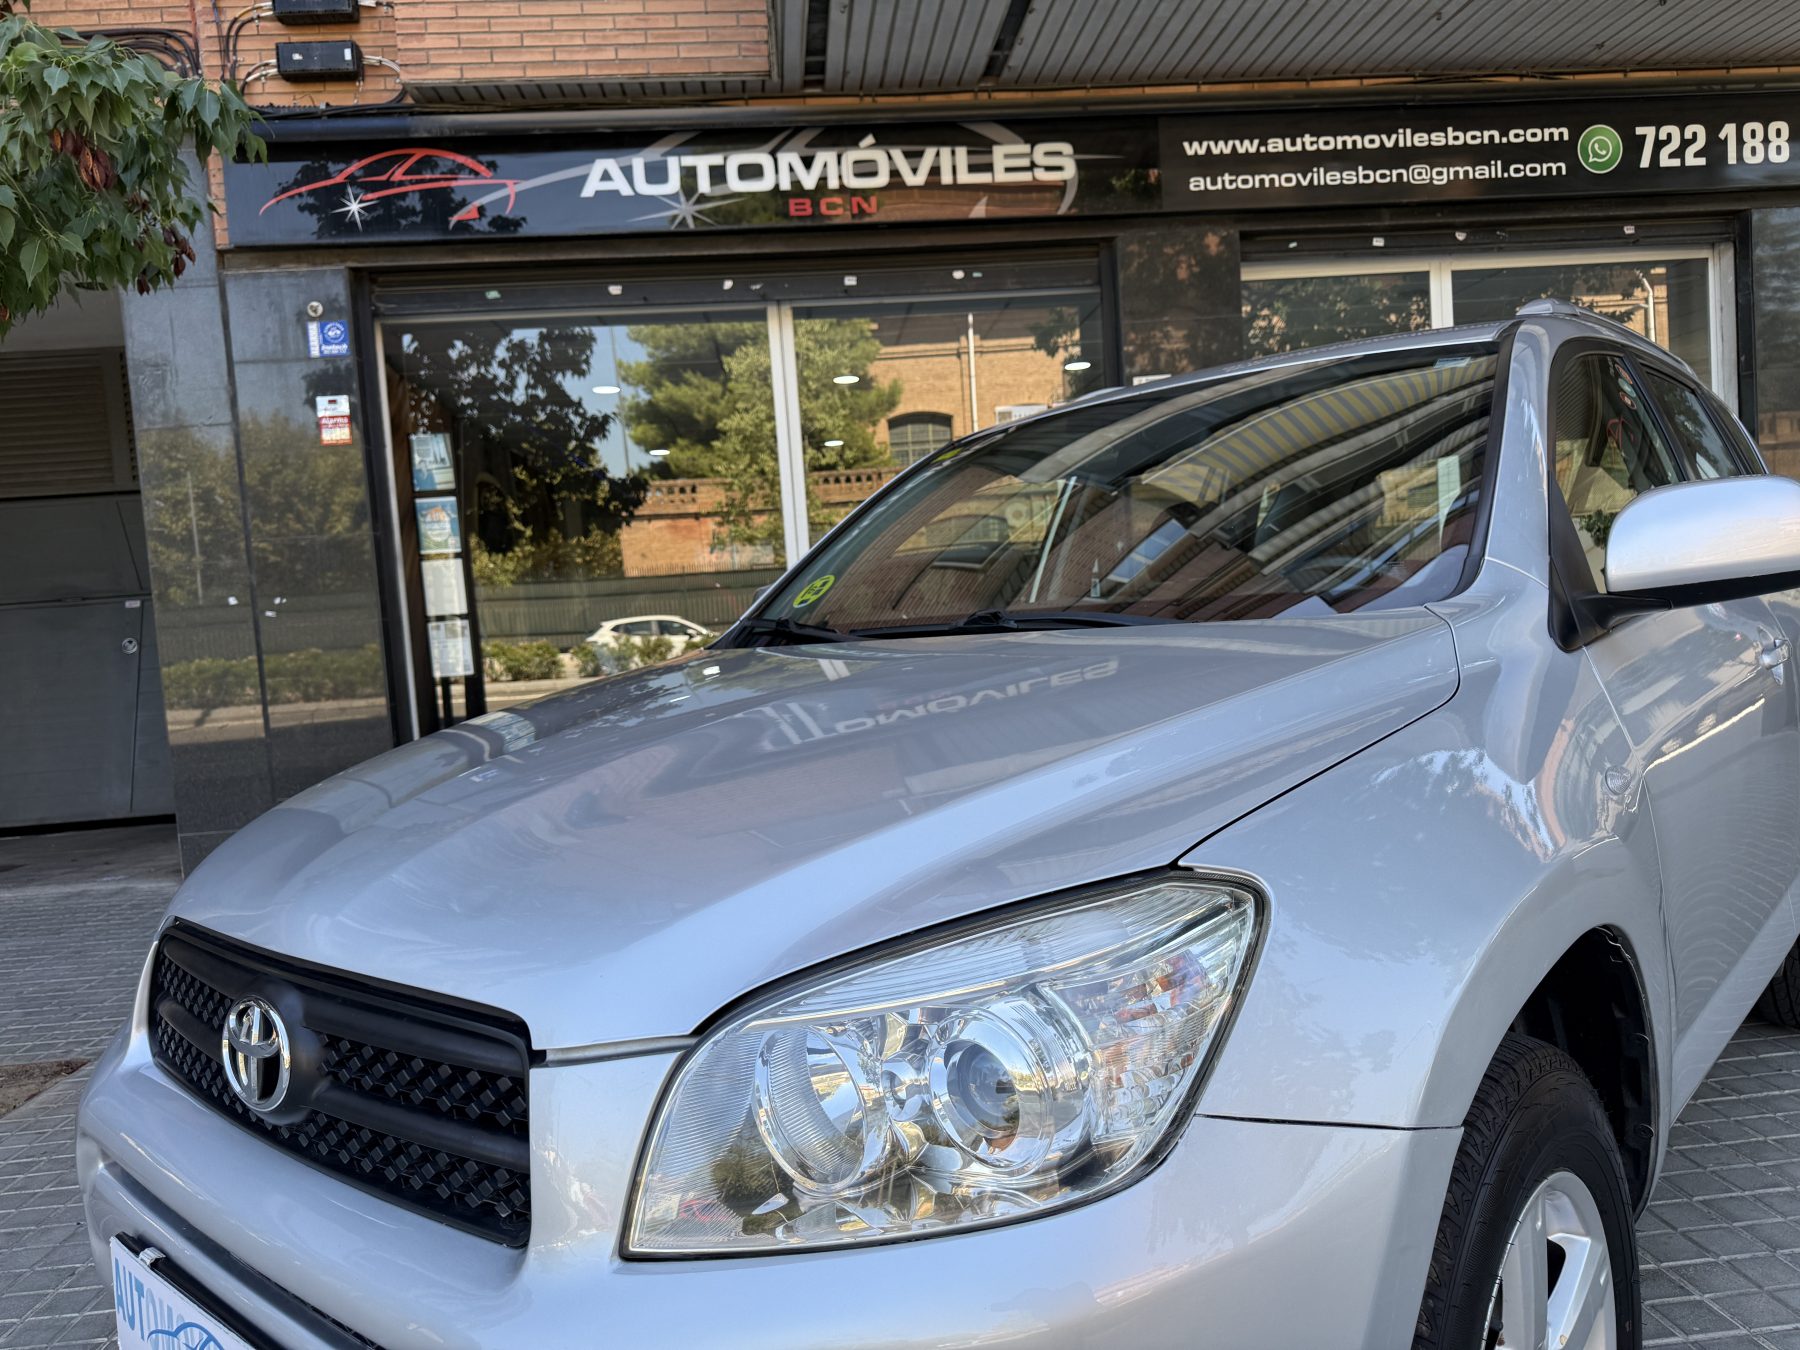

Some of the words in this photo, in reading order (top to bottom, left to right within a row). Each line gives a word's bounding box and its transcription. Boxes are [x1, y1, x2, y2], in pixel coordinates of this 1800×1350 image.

[1182, 123, 1570, 157] www.automovilesbcn.com
[1634, 123, 1708, 169] 722
[1718, 120, 1791, 165] 188
[580, 133, 1077, 199] AUTOMÓVILES
[1188, 158, 1568, 193] automovilesbcn@gmail.com
[788, 195, 878, 218] BCN
